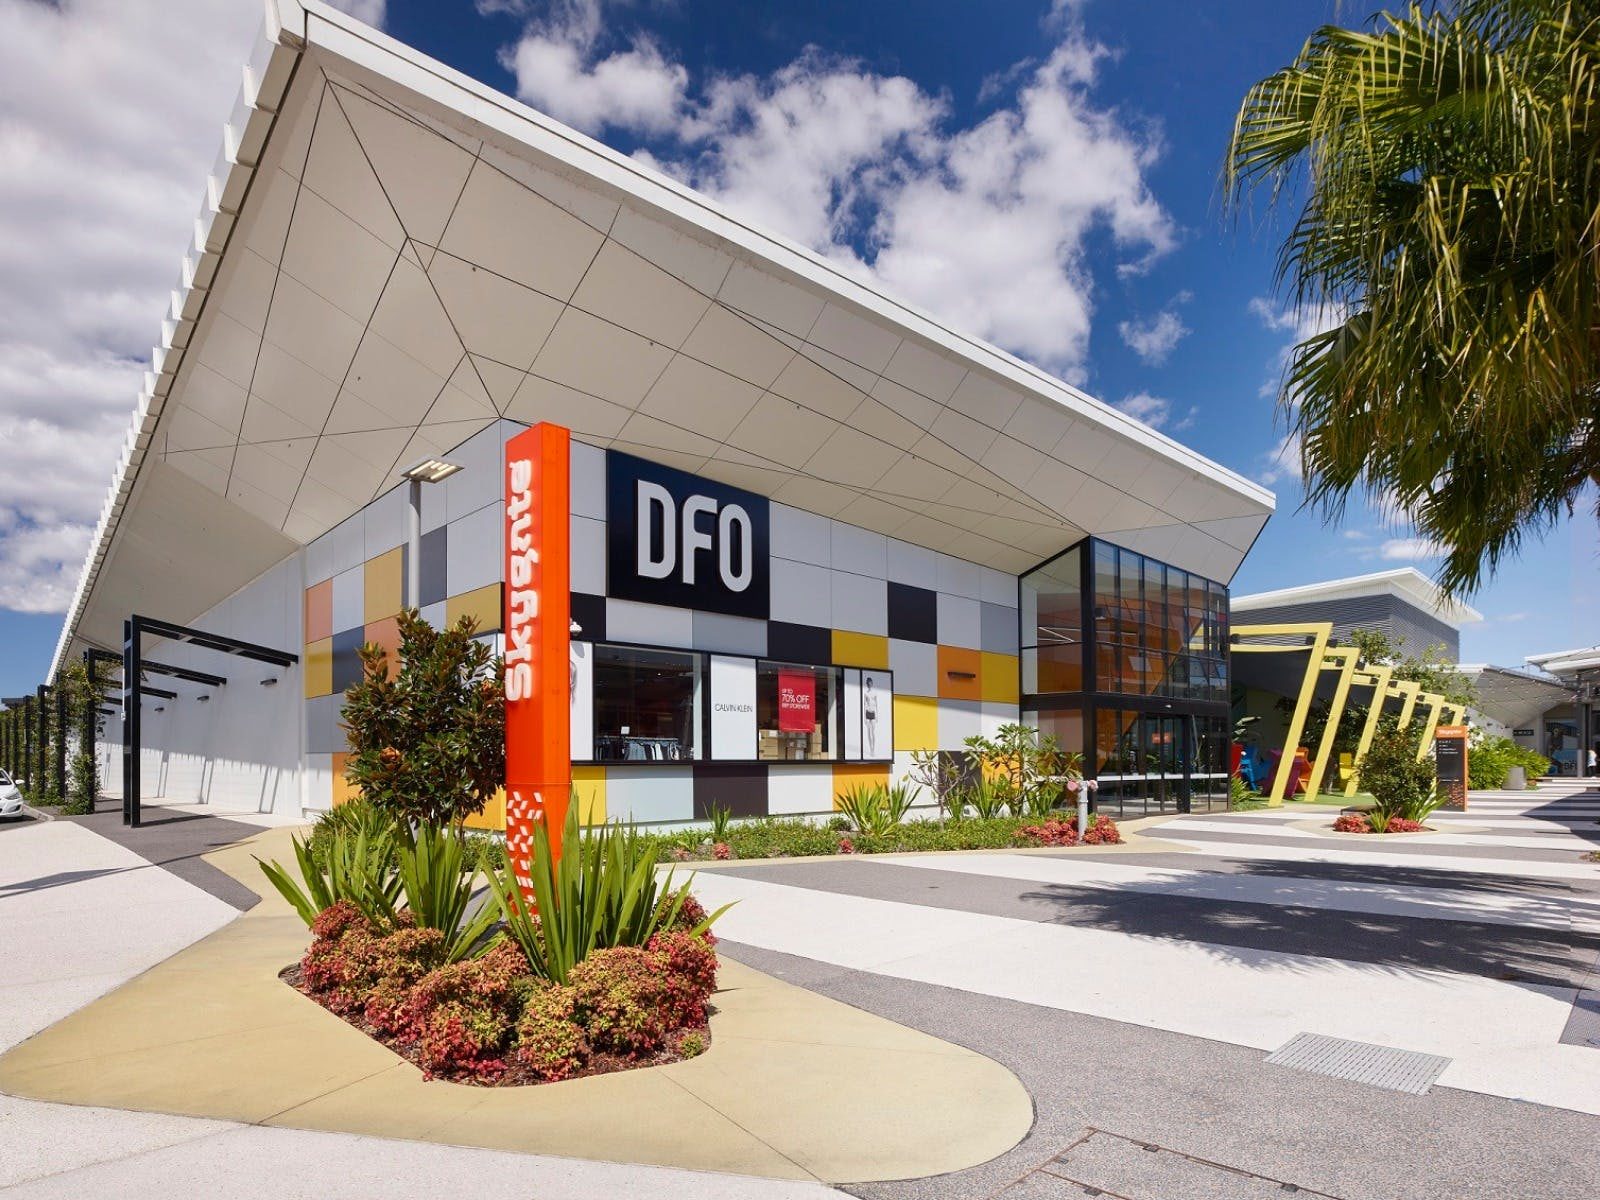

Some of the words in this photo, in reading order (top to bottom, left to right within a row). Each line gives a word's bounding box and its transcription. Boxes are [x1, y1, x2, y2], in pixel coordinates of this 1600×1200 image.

[637, 479, 752, 592] DFO
[504, 458, 539, 702] Skygate
[714, 703, 736, 712] CALVIN
[737, 704, 753, 712] KLEIN
[782, 693, 796, 703] 70%
[796, 694, 810, 704] OFF
